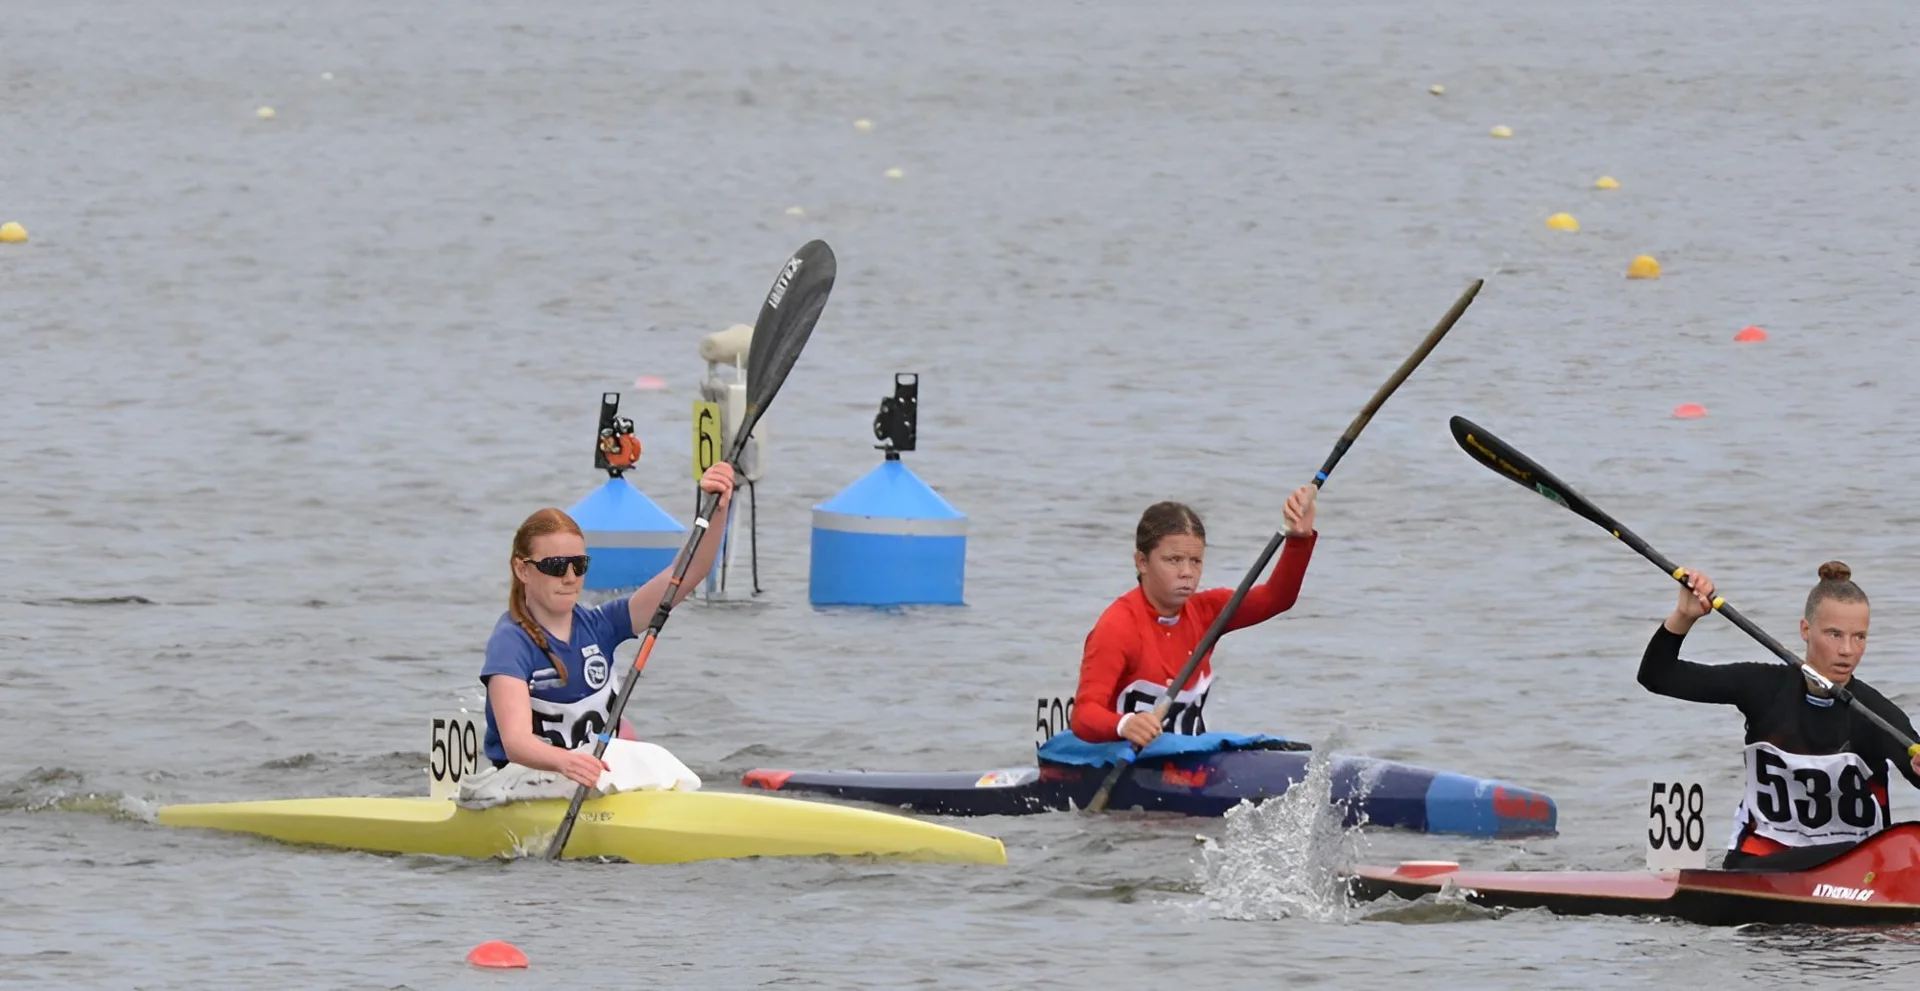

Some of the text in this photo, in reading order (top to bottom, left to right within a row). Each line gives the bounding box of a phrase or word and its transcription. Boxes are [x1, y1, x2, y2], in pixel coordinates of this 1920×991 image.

[699, 408, 713, 473] 6
[431, 719, 477, 782] 509
[1648, 782, 1704, 851] 538
[1756, 749, 1875, 828] 538
